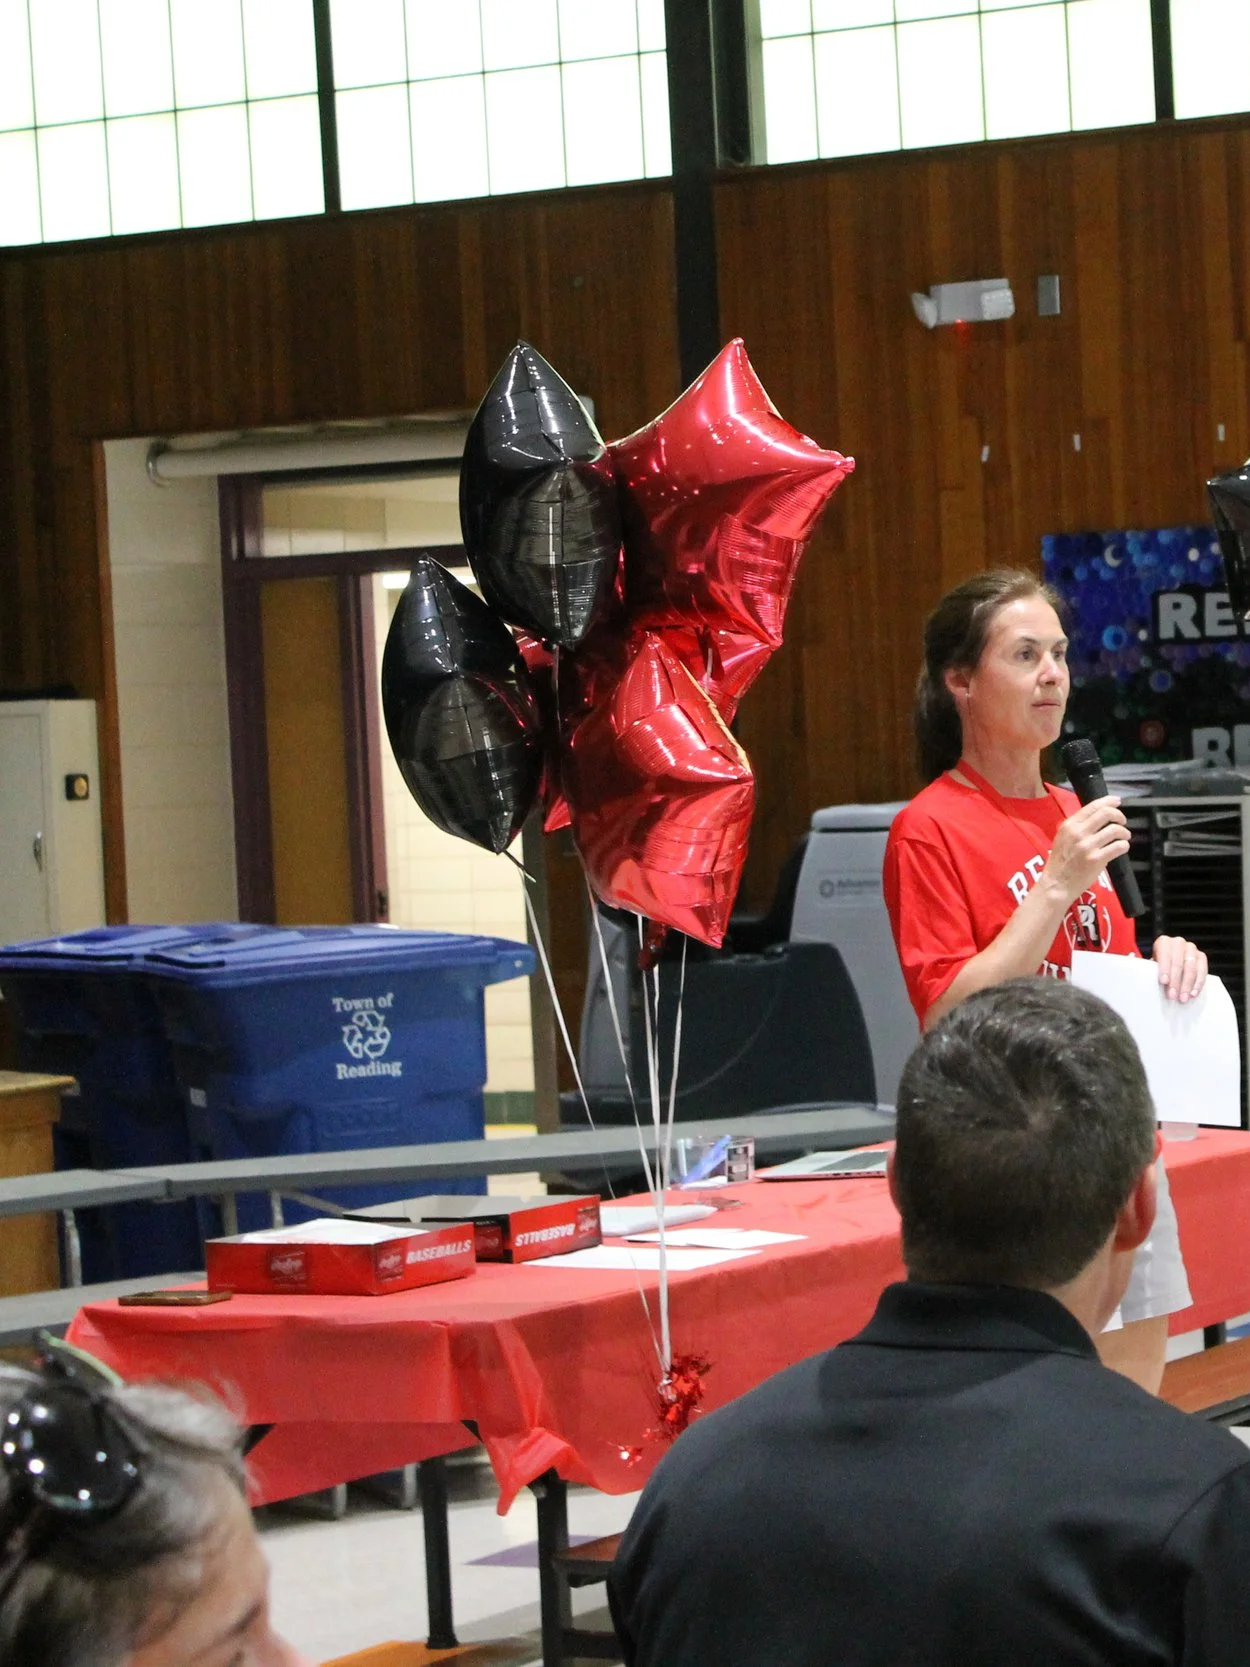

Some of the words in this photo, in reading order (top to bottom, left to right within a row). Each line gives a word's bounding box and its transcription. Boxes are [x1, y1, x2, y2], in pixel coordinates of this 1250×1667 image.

[332, 997, 375, 1013] Town
[377, 992, 394, 1008] of
[335, 1060, 402, 1080] Reading
[514, 1223, 576, 1247] BASEBALLS
[405, 1239, 472, 1265] BASEBALLS
